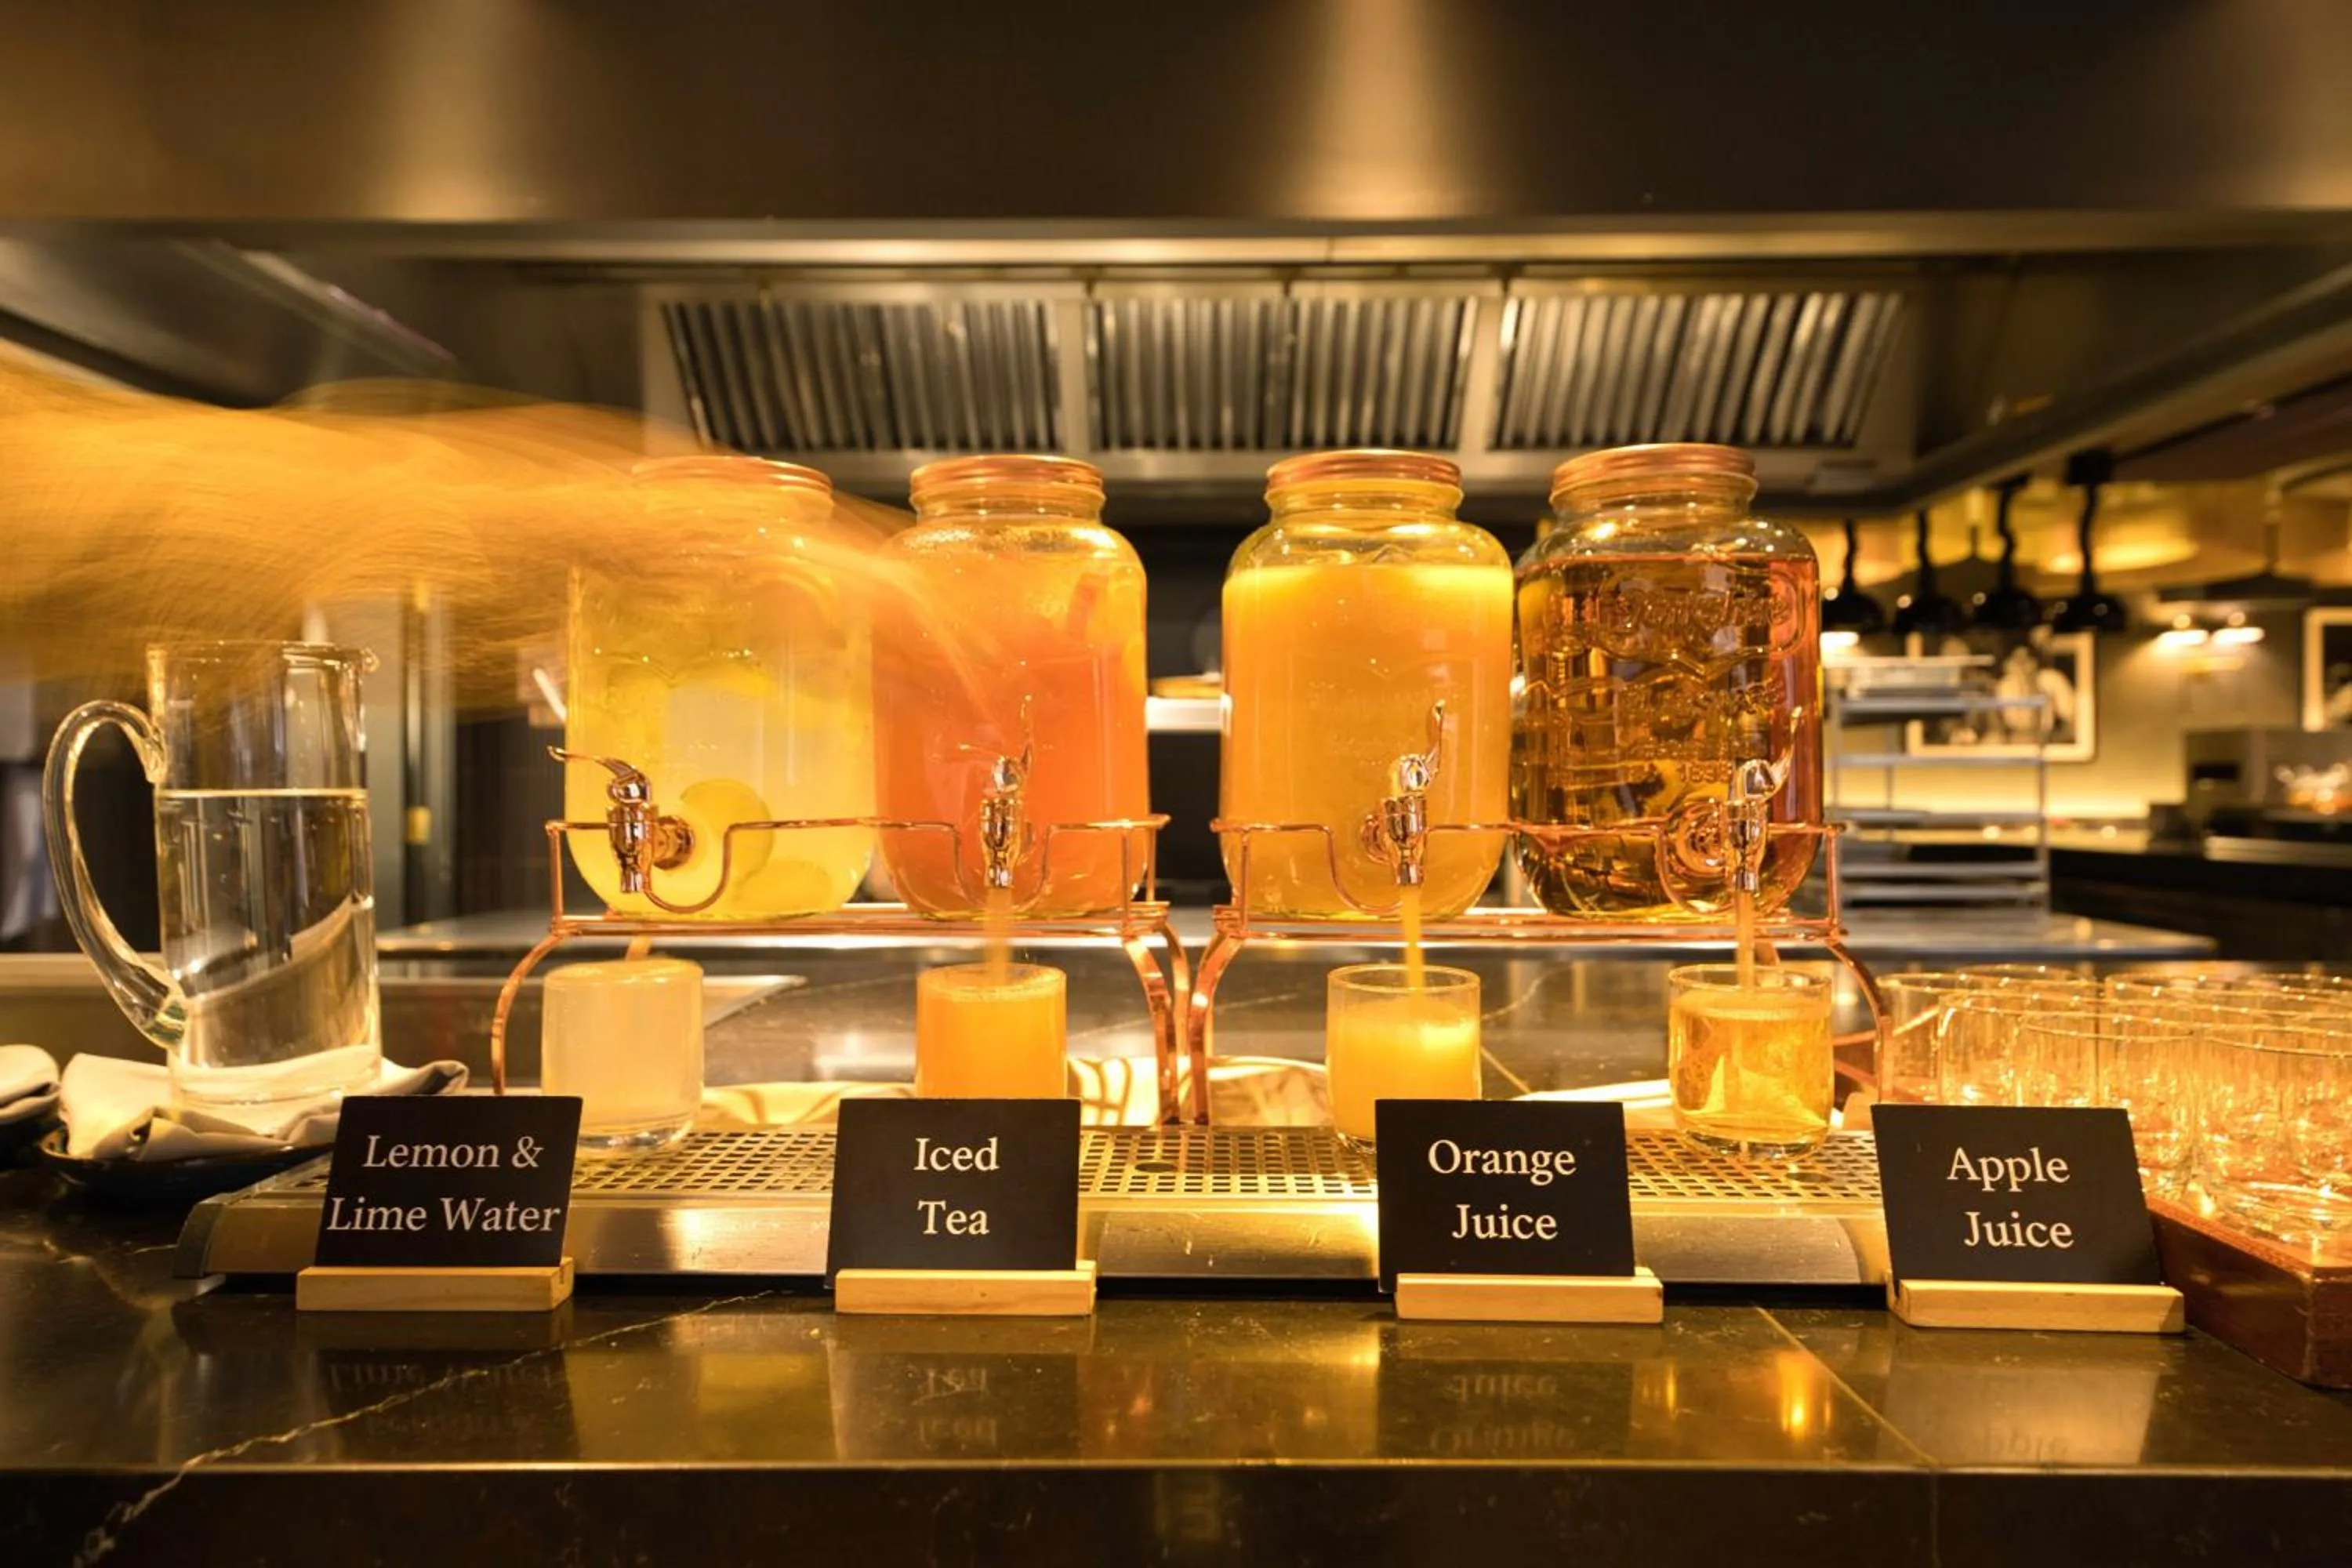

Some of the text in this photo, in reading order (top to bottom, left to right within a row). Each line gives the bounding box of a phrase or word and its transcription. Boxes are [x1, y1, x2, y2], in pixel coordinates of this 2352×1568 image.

[361, 1134, 544, 1169] Lemon &
[913, 1136, 1000, 1173] Iced
[1427, 1138, 1577, 1187] Orange
[1946, 1145, 2071, 1193] Apple
[326, 1196, 561, 1232] Lime Water
[916, 1199, 991, 1236] Tea
[1451, 1203, 1559, 1241] Juice
[1963, 1210, 2075, 1250] Juice
